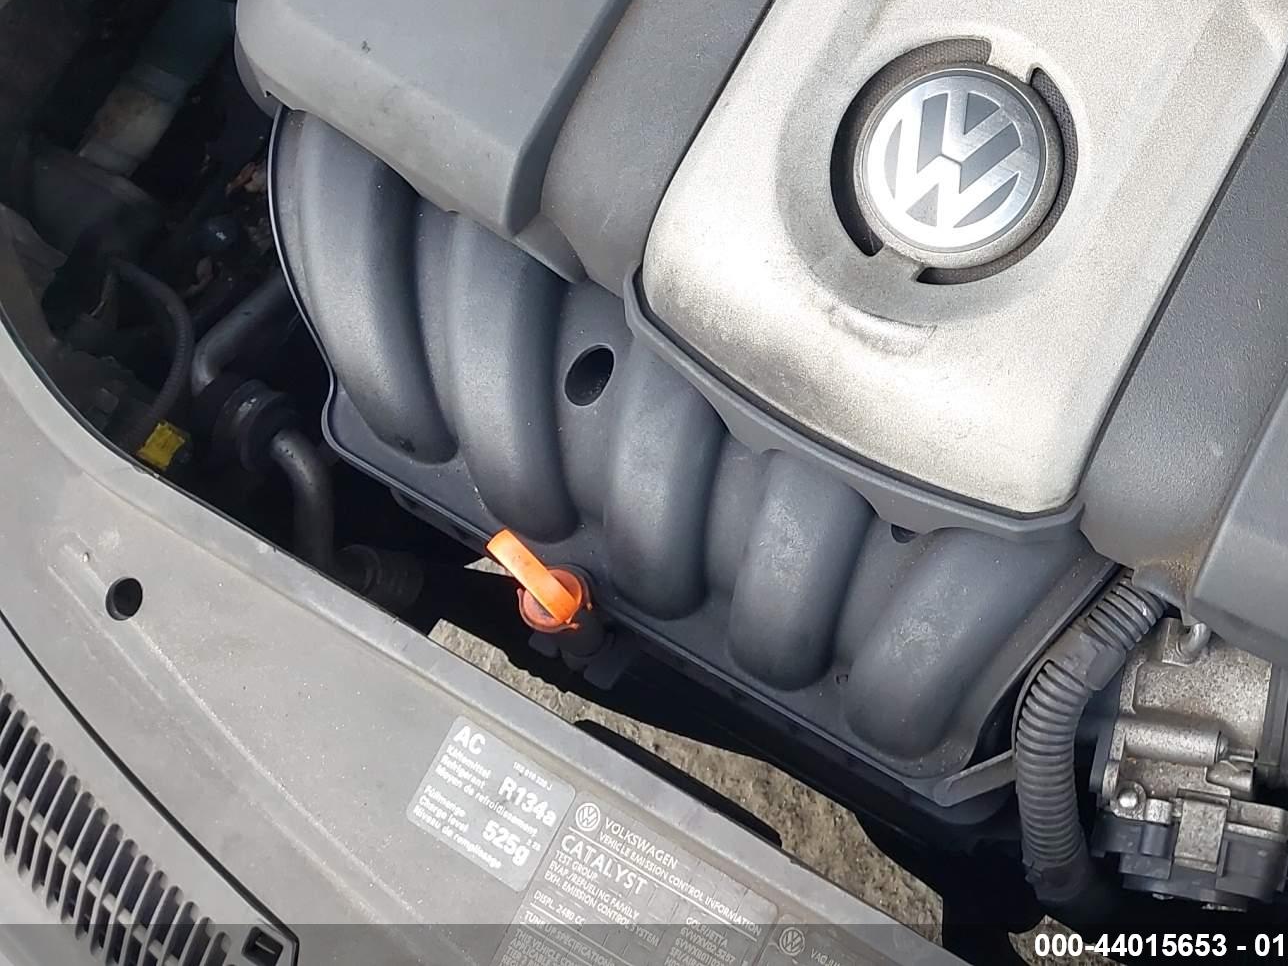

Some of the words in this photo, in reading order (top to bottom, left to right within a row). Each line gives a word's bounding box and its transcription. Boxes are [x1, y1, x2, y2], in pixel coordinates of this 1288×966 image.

[454, 725, 486, 754] AC
[434, 764, 464, 787] Moyen
[463, 783, 475, 795] de
[417, 795, 448, 819] Charge
[447, 814, 468, 832] level
[498, 777, 557, 826] R134a
[412, 805, 441, 828] Niveau
[441, 824, 454, 836] de
[452, 833, 502, 869] remplissage
[480, 822, 531, 865] 525g
[602, 818, 678, 869] VOLKSWAGEN
[554, 850, 571, 865] TEST
[571, 861, 597, 881] GROUP
[559, 834, 646, 894] CATALYST
[598, 832, 631, 857] VEHICLE
[629, 851, 668, 879] EMISSION
[667, 874, 705, 901] CONTROL
[704, 896, 762, 935] INFORMATION
[544, 870, 563, 886] EXH.
[561, 881, 597, 907] EMISSION
[596, 902, 630, 927] CONTROL
[629, 922, 659, 945] SYSTEM
[609, 898, 639, 920] FAMILY
[514, 929, 531, 943] THIS
